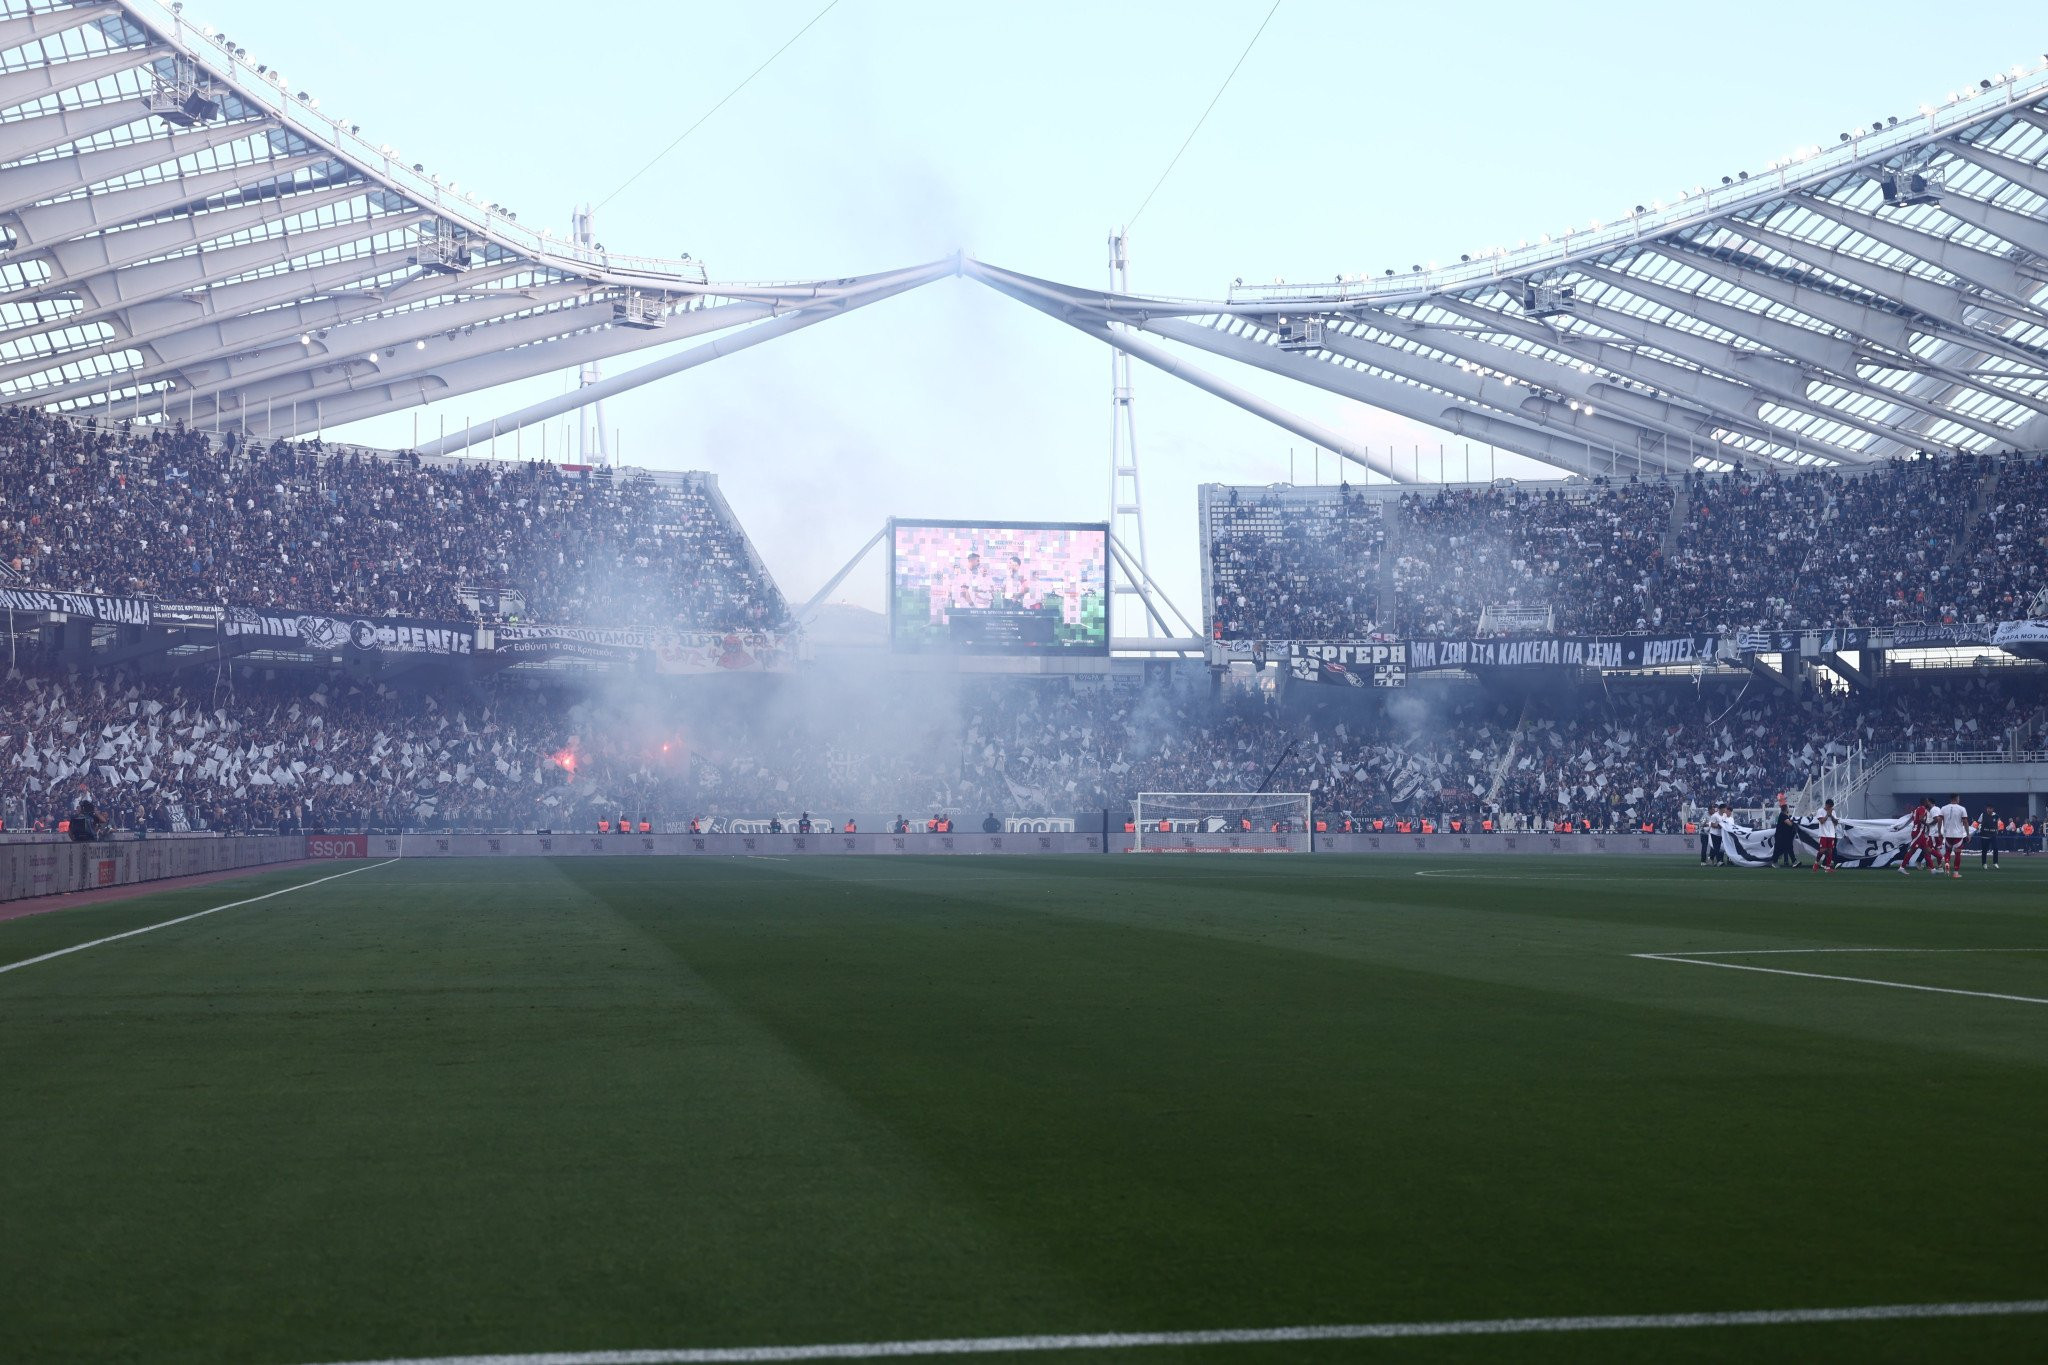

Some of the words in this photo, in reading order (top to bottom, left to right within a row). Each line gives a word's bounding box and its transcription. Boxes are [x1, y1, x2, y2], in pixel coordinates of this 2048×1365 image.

[55, 594, 96, 618] ΣΤΗΝ
[96, 598, 150, 625] ΕΛΛΑΔΑ
[1410, 641, 1437, 668] ΜΙΑ
[1440, 641, 1467, 665] ΖΩΗ
[1470, 642, 1495, 665] ΣΤΑ
[1498, 640, 1560, 665] ΚΑΓΚΕΛΑ
[1586, 642, 1622, 667] ΣΕΝΑ
